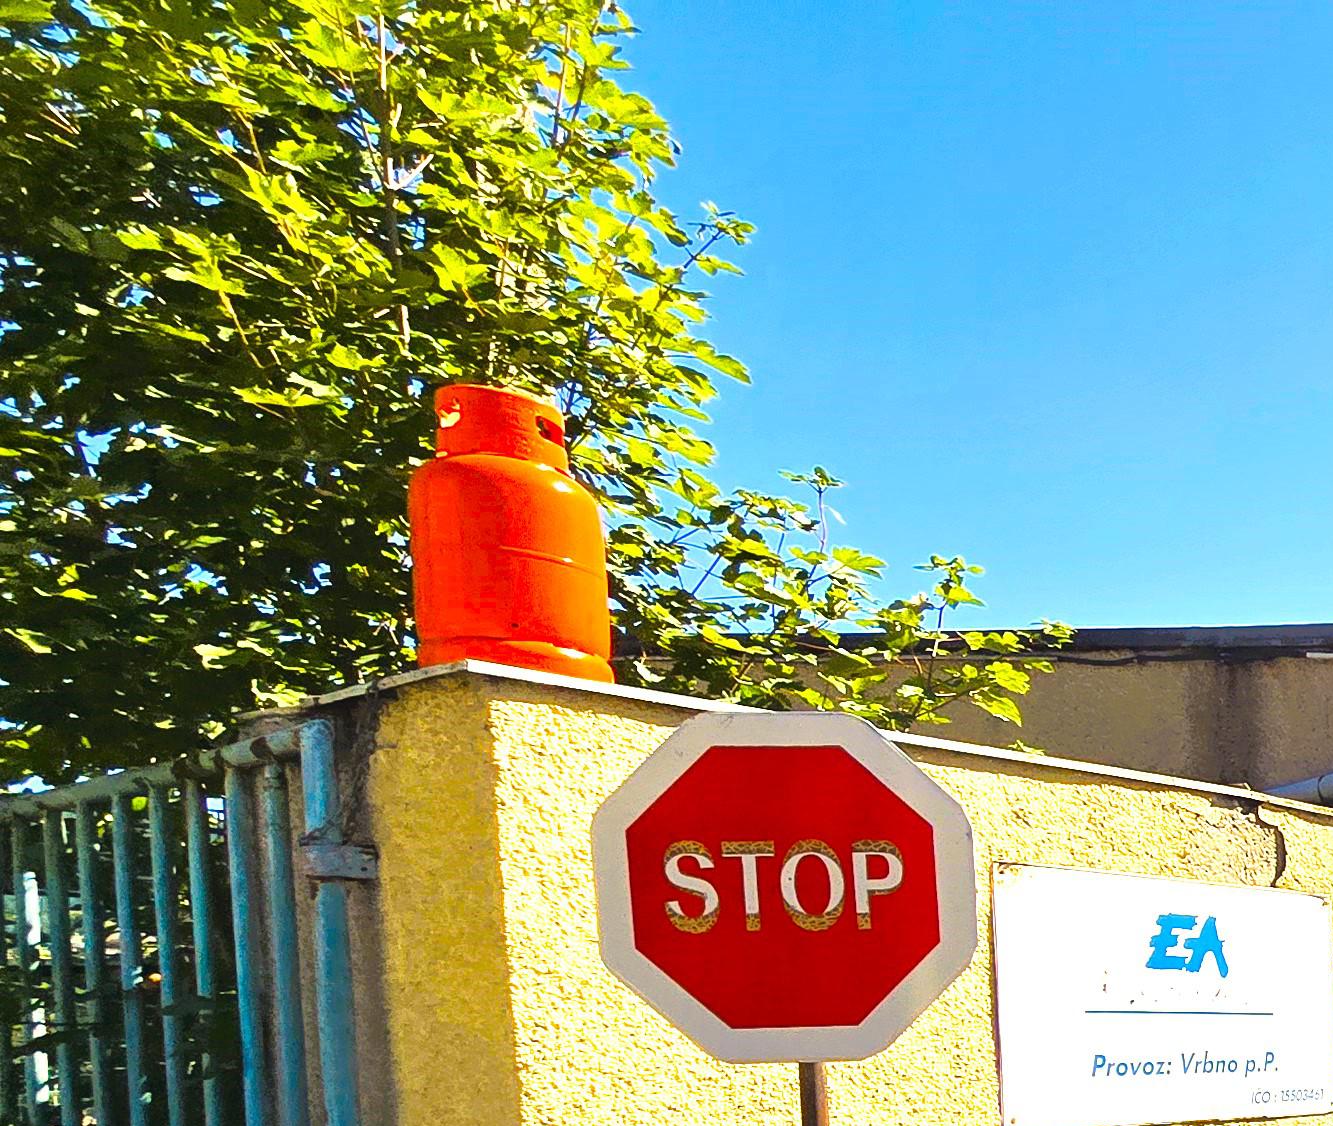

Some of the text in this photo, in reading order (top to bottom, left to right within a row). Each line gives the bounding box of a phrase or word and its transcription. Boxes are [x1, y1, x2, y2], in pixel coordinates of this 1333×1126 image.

[664, 839, 904, 934] STOP
[1145, 913, 1229, 978] EA
[1091, 1054, 1172, 1078] Provoz:
[1180, 1050, 1238, 1075] Vrbno
